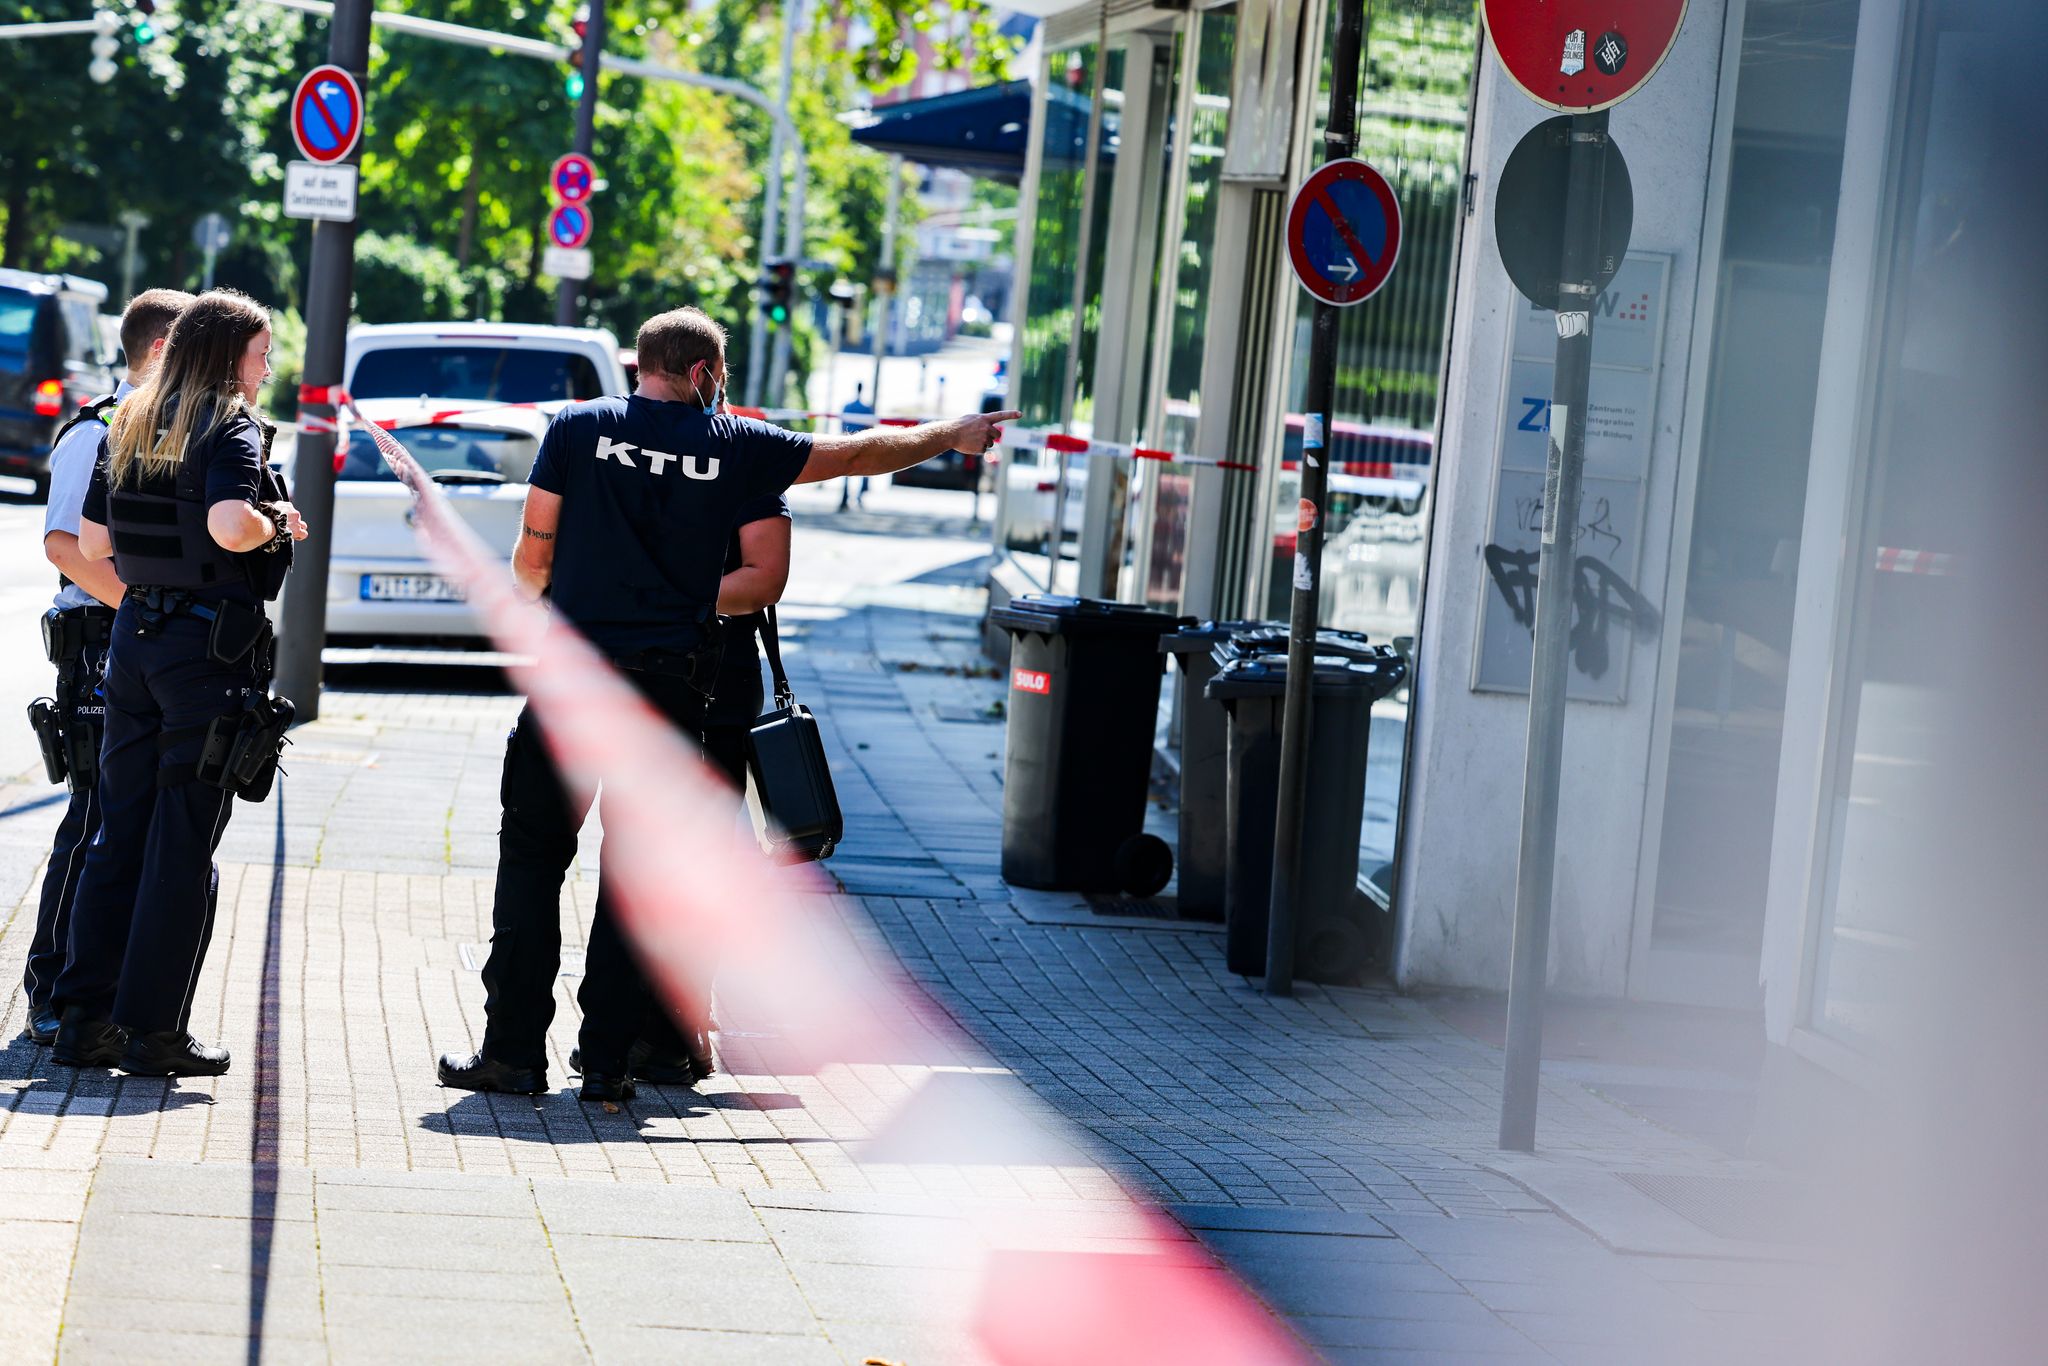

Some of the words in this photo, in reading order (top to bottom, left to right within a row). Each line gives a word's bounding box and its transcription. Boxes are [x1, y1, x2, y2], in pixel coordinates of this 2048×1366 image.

[1588, 404, 1622, 414] Zentrum
[1625, 407, 1635, 415] für
[1587, 416, 1634, 427] Integration
[1603, 430, 1632, 440] Bildung
[595, 435, 720, 480] KTU
[1016, 671, 1045, 690] SULO
[77, 705, 106, 715] POLIZEI
